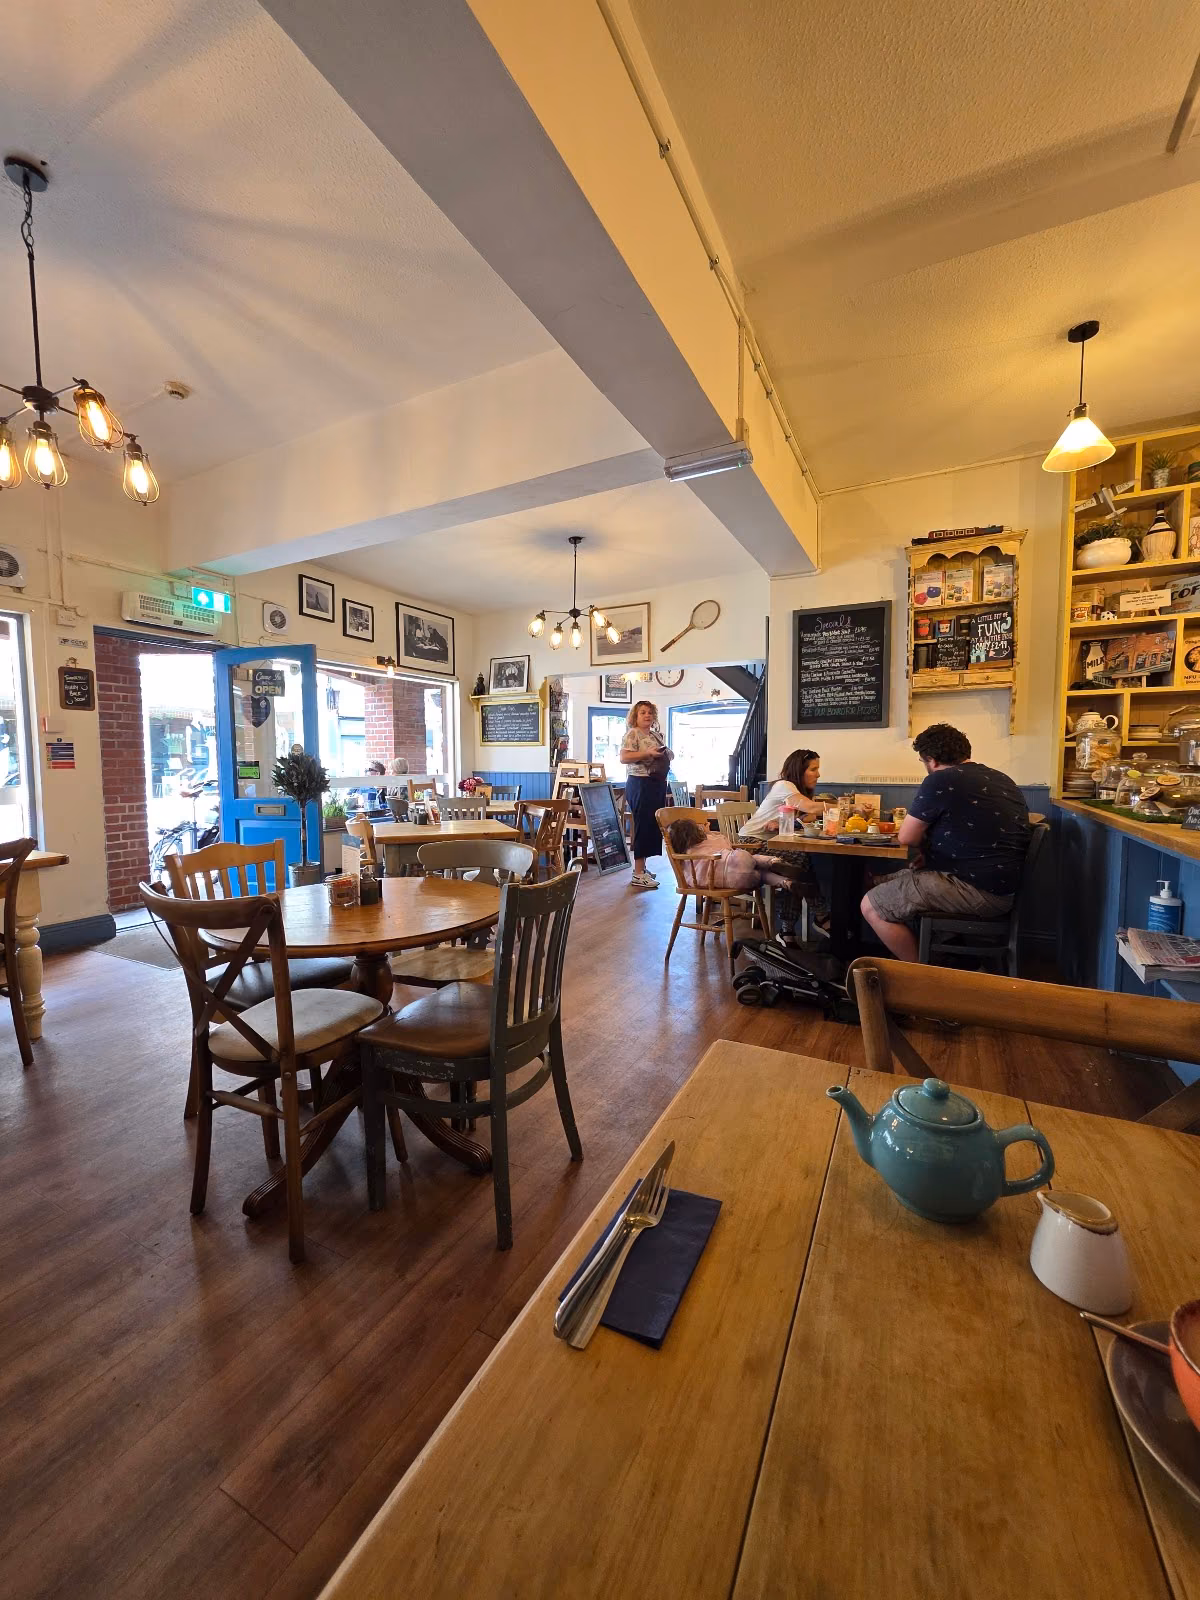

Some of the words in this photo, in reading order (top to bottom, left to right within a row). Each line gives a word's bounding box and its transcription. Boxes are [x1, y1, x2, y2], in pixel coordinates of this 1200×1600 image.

[978, 614, 992, 622] LITTLE
[977, 620, 1001, 637] FUN
[1086, 655, 1105, 669] MILK
[255, 685, 281, 694] OPEN
